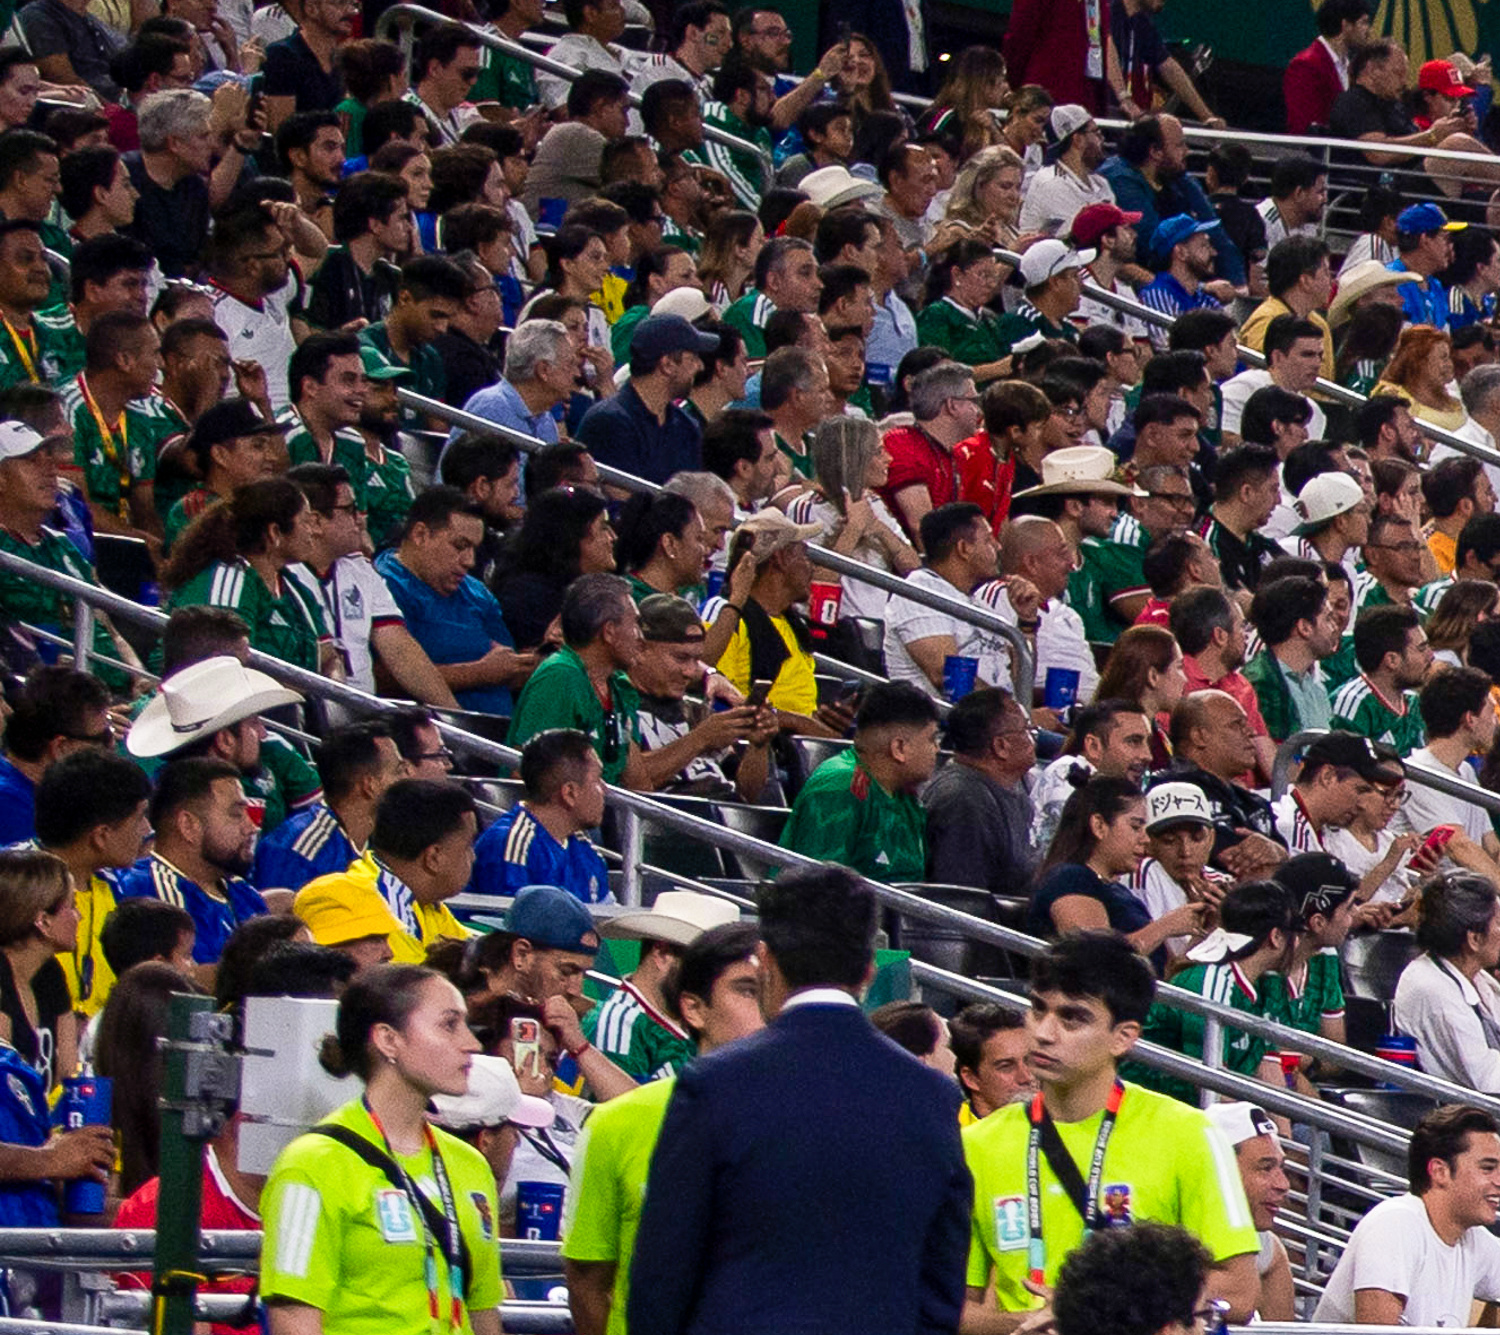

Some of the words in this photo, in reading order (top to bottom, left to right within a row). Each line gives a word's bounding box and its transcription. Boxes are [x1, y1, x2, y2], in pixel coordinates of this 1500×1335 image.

[1150, 792, 1205, 817] ドジャース
